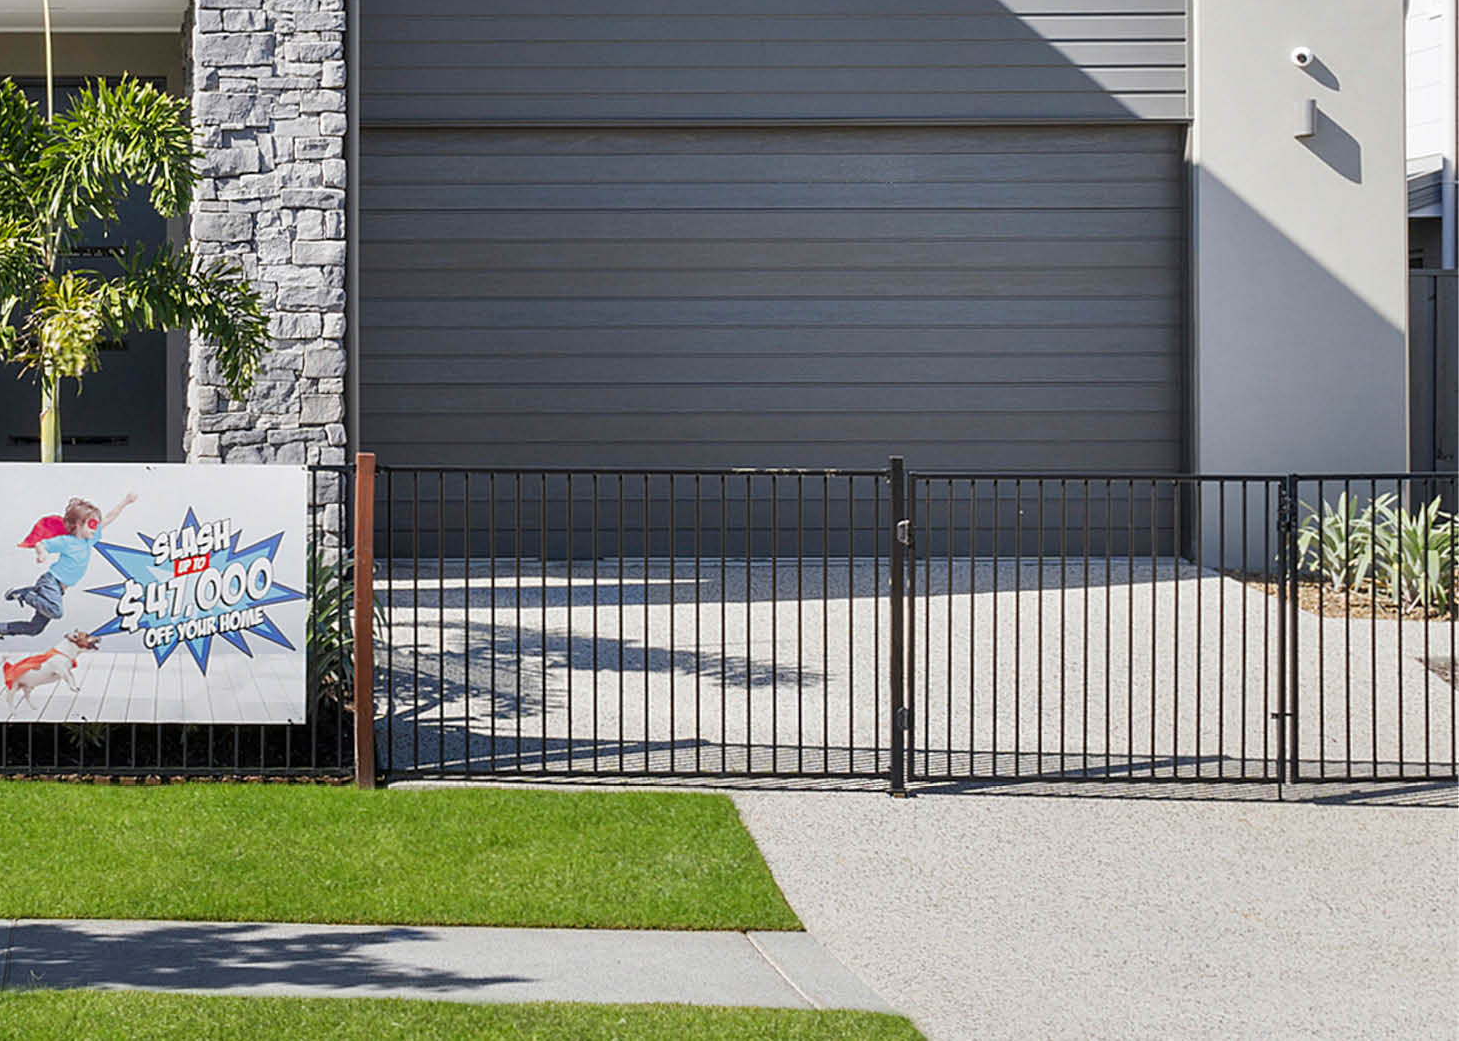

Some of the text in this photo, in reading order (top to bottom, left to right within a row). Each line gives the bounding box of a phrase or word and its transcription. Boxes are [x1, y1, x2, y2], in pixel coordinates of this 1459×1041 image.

[151, 518, 231, 566] SLASH
[177, 557, 208, 574] UP TO
[116, 557, 273, 633] $47,000
[144, 607, 264, 649] OFF YOUR HOME
